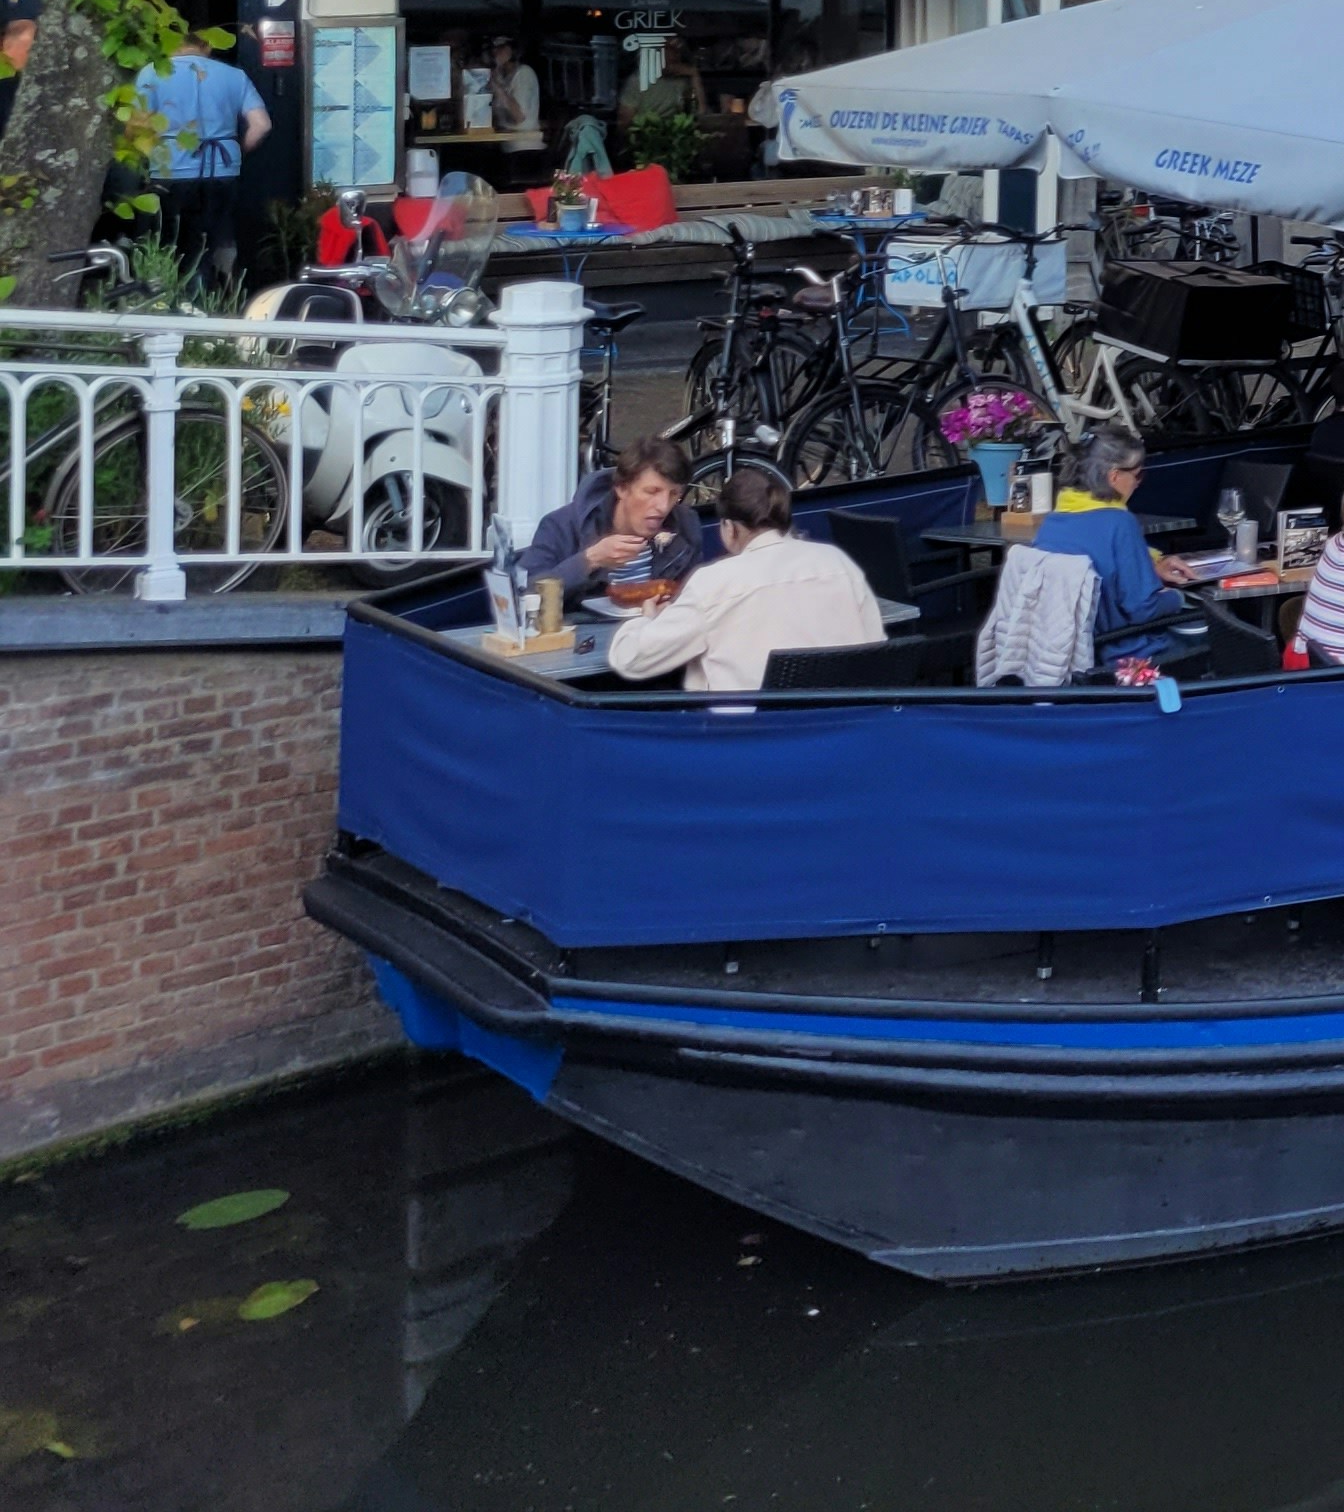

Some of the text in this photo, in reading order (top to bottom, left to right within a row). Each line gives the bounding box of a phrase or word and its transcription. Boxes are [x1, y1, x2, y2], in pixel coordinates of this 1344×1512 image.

[614, 8, 687, 29] GRIEK
[829, 110, 877, 130] OUZERI
[882, 111, 898, 131] DE
[902, 112, 946, 134] KLEINE
[949, 115, 990, 136] GRIEK
[1155, 148, 1262, 184] GREEK MEZE
